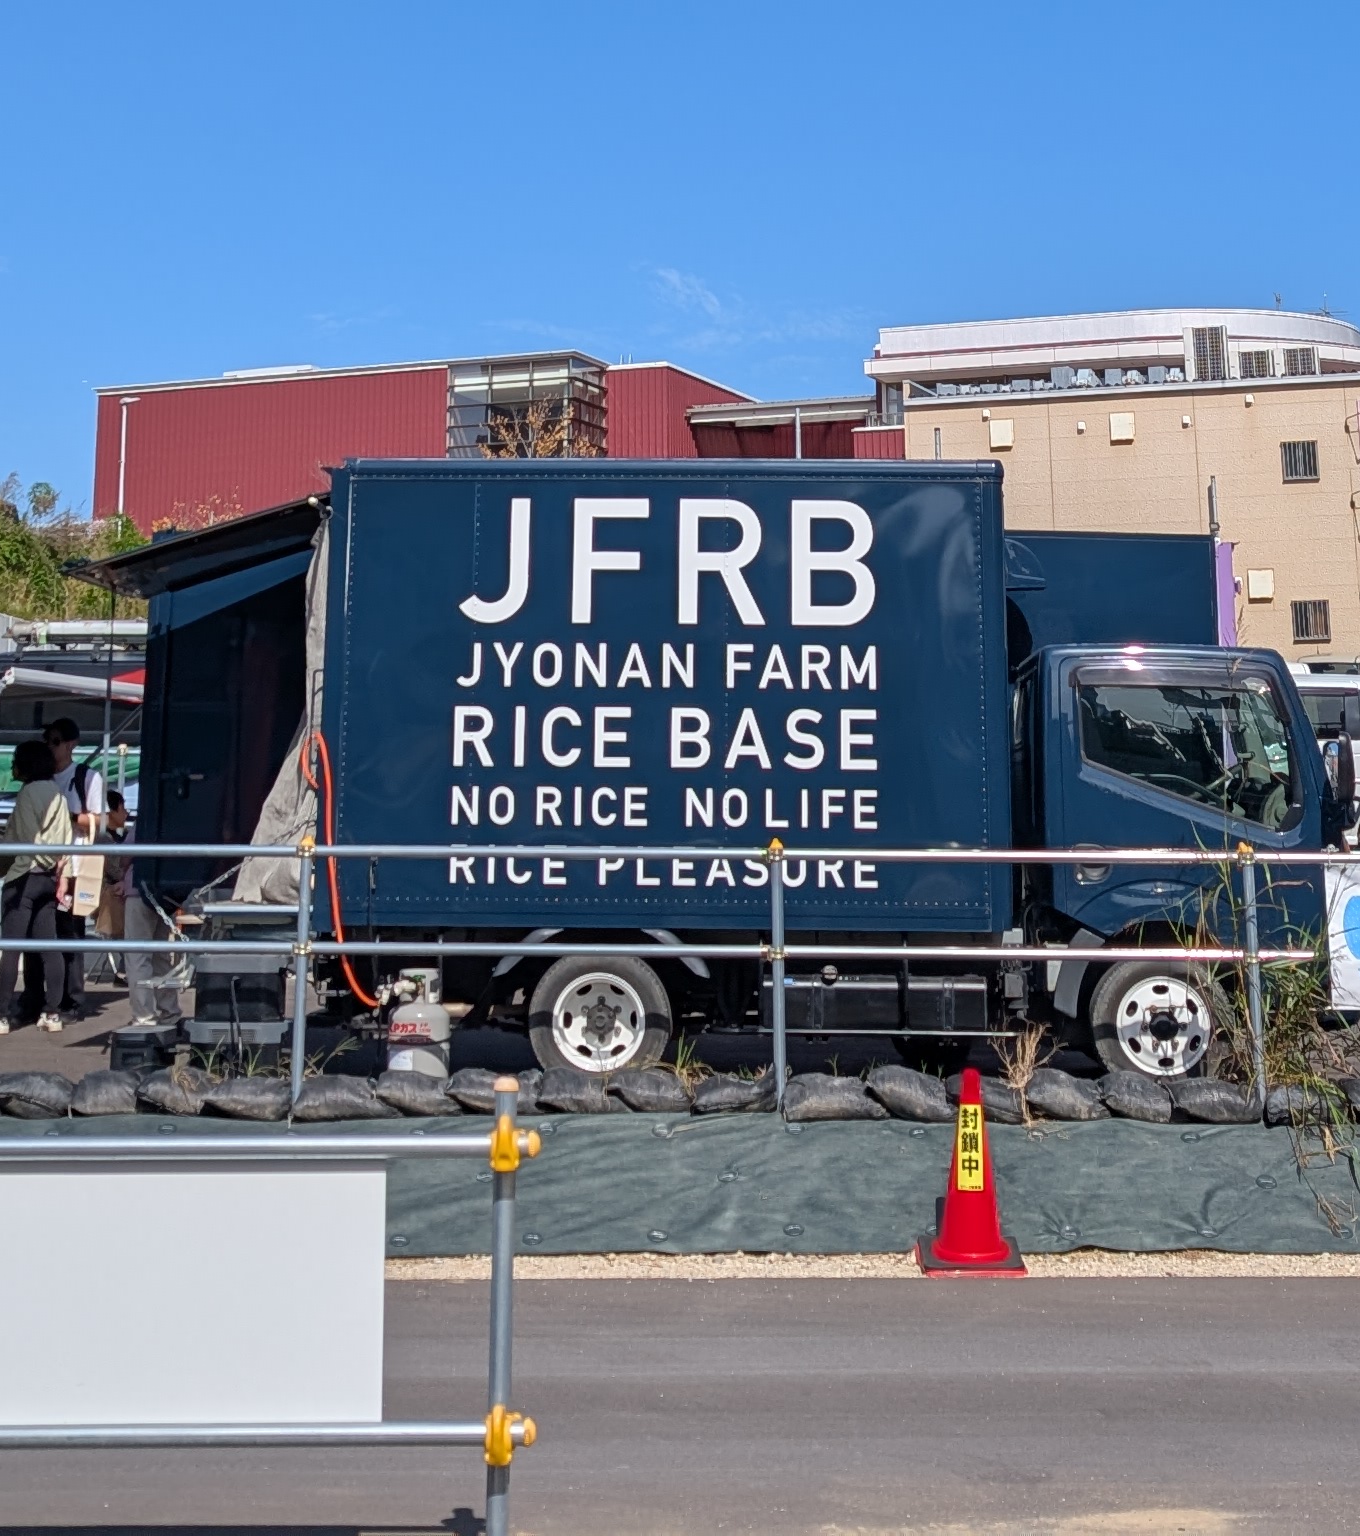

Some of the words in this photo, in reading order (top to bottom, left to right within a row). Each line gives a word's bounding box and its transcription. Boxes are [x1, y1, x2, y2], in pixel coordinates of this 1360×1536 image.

[459, 497, 876, 626] JFRB
[456, 642, 695, 688] JYONAN
[726, 644, 877, 691] FARM
[453, 705, 632, 768] RICE
[670, 707, 878, 771] BASE
[451, 786, 515, 826] NO
[536, 786, 648, 827] RICE
[685, 788, 748, 828] NO
[765, 788, 878, 830] LIFE
[449, 844, 567, 886] RICE
[598, 845, 879, 889] PLEASURE
[961, 1107, 980, 1178] 封鎖中
